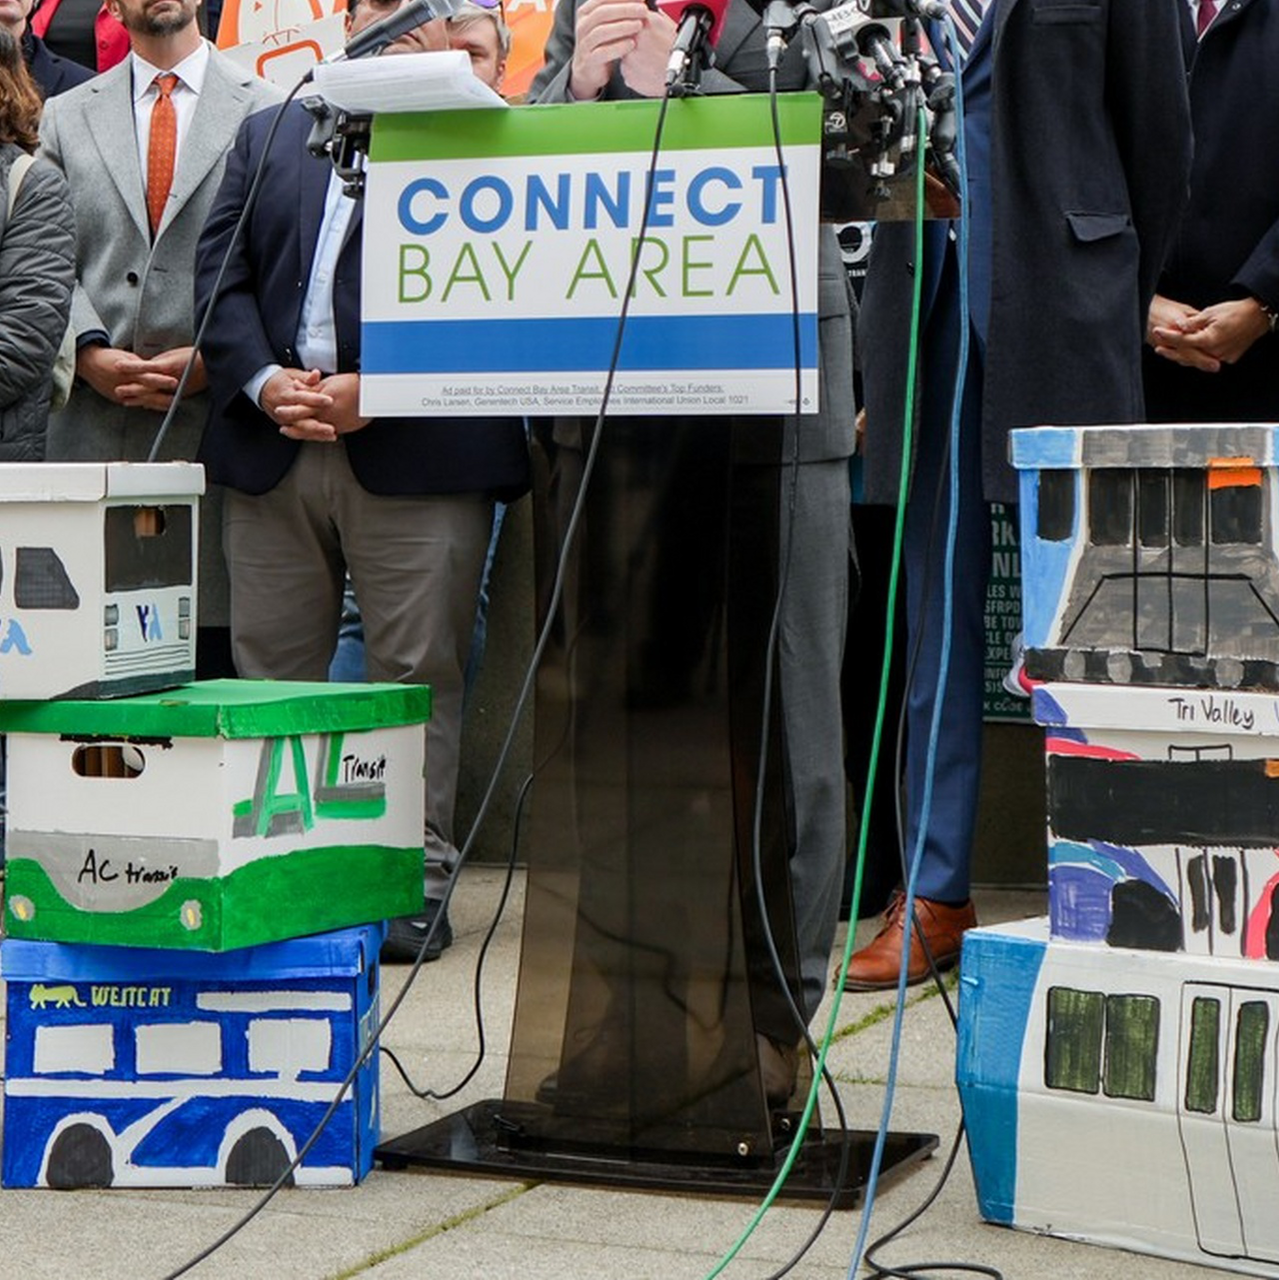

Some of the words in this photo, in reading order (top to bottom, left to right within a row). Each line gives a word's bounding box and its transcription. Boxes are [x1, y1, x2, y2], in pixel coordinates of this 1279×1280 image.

[396, 164, 788, 236] CONNECT
[397, 239, 533, 304] BAY
[565, 233, 781, 300] AREA
[421, 397, 442, 407] Chris
[474, 397, 519, 407] Genentech
[543, 396, 574, 407] Service
[575, 395, 621, 407] Emploes
[623, 395, 675, 406] International
[676, 394, 702, 405] Union
[703, 394, 726, 405] Local
[728, 394, 750, 405] 1021
[454, 386, 471, 397] paid
[497, 385, 532, 395] Connect
[533, 384, 548, 396] Bay
[550, 384, 570, 394] Area
[671, 383, 685, 396] Top
[1167, 696, 1195, 721] Tri
[1200, 694, 1255, 730] Valley
[342, 753, 387, 783] Transit
[77, 848, 120, 885] AC
[124, 861, 179, 885] transit
